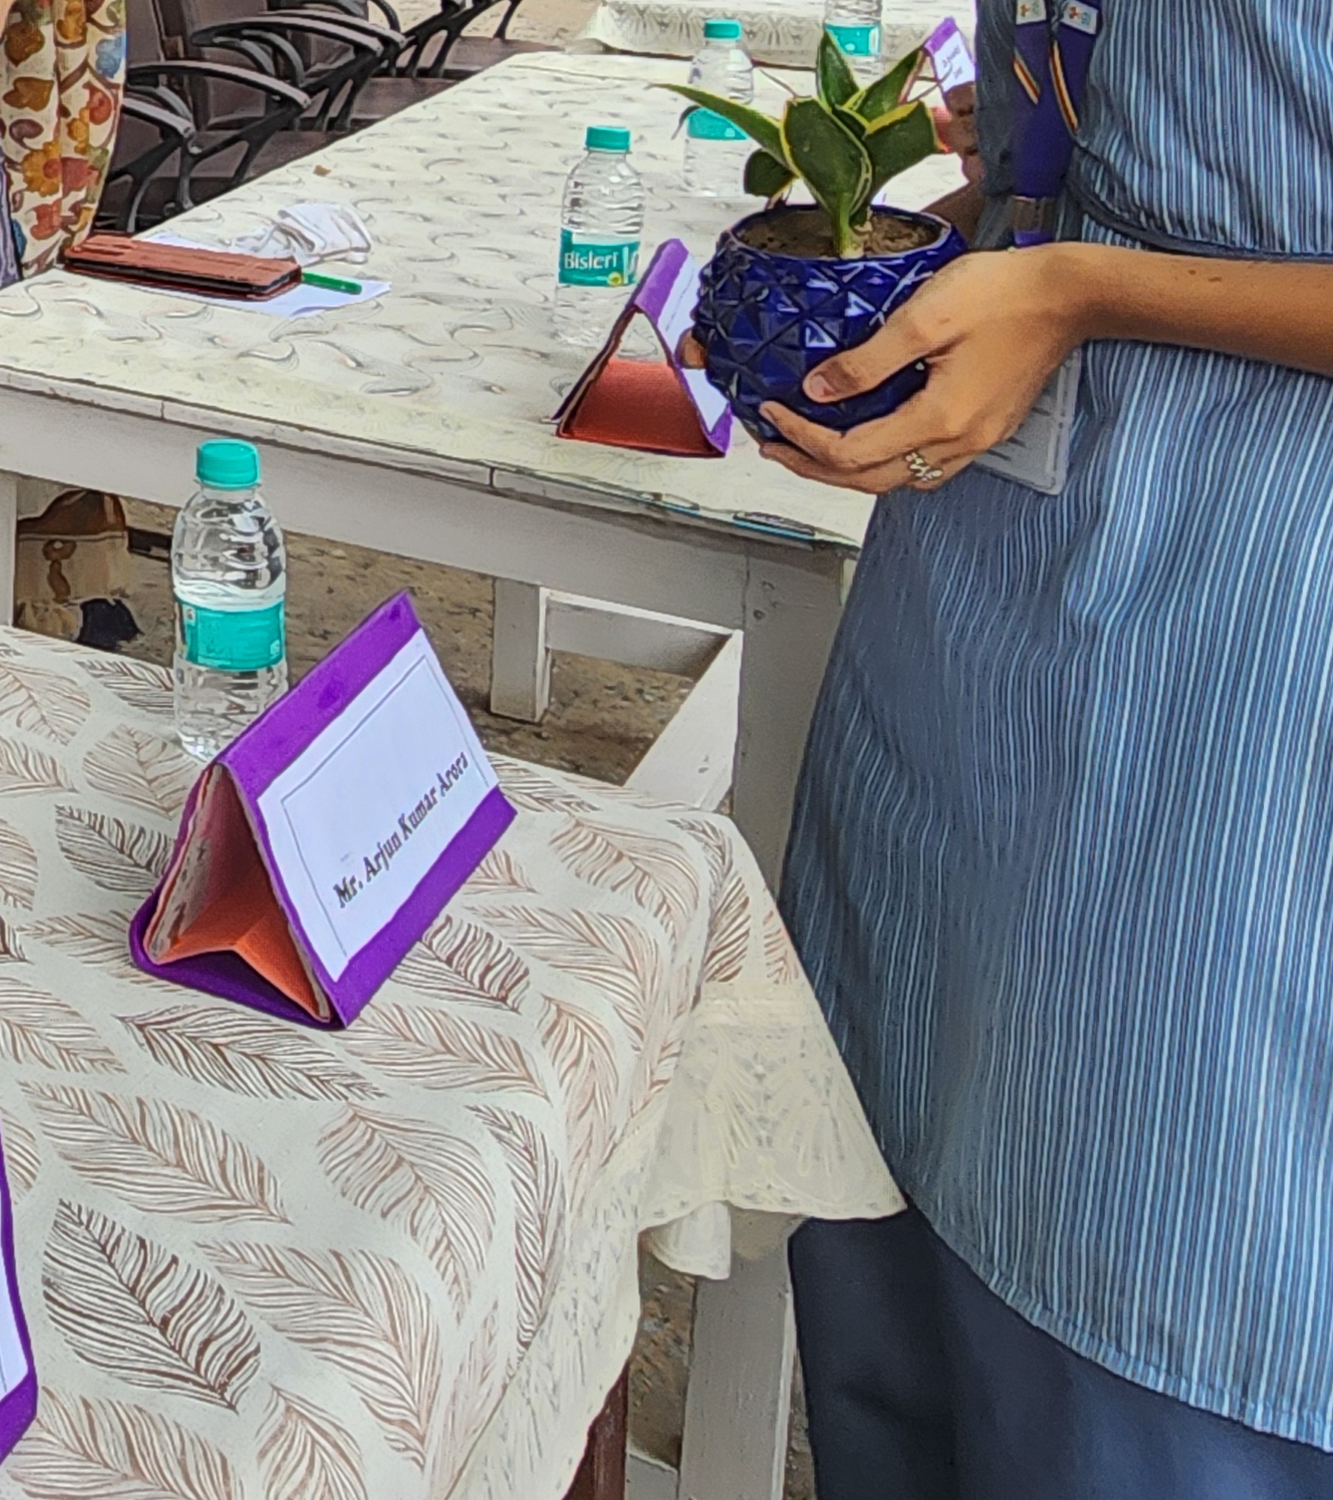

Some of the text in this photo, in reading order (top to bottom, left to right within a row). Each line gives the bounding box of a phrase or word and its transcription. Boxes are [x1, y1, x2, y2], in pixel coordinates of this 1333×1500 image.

[564, 250, 619, 270] Bisleri
[333, 751, 469, 909] Mr. Arjun Kumar Arora
